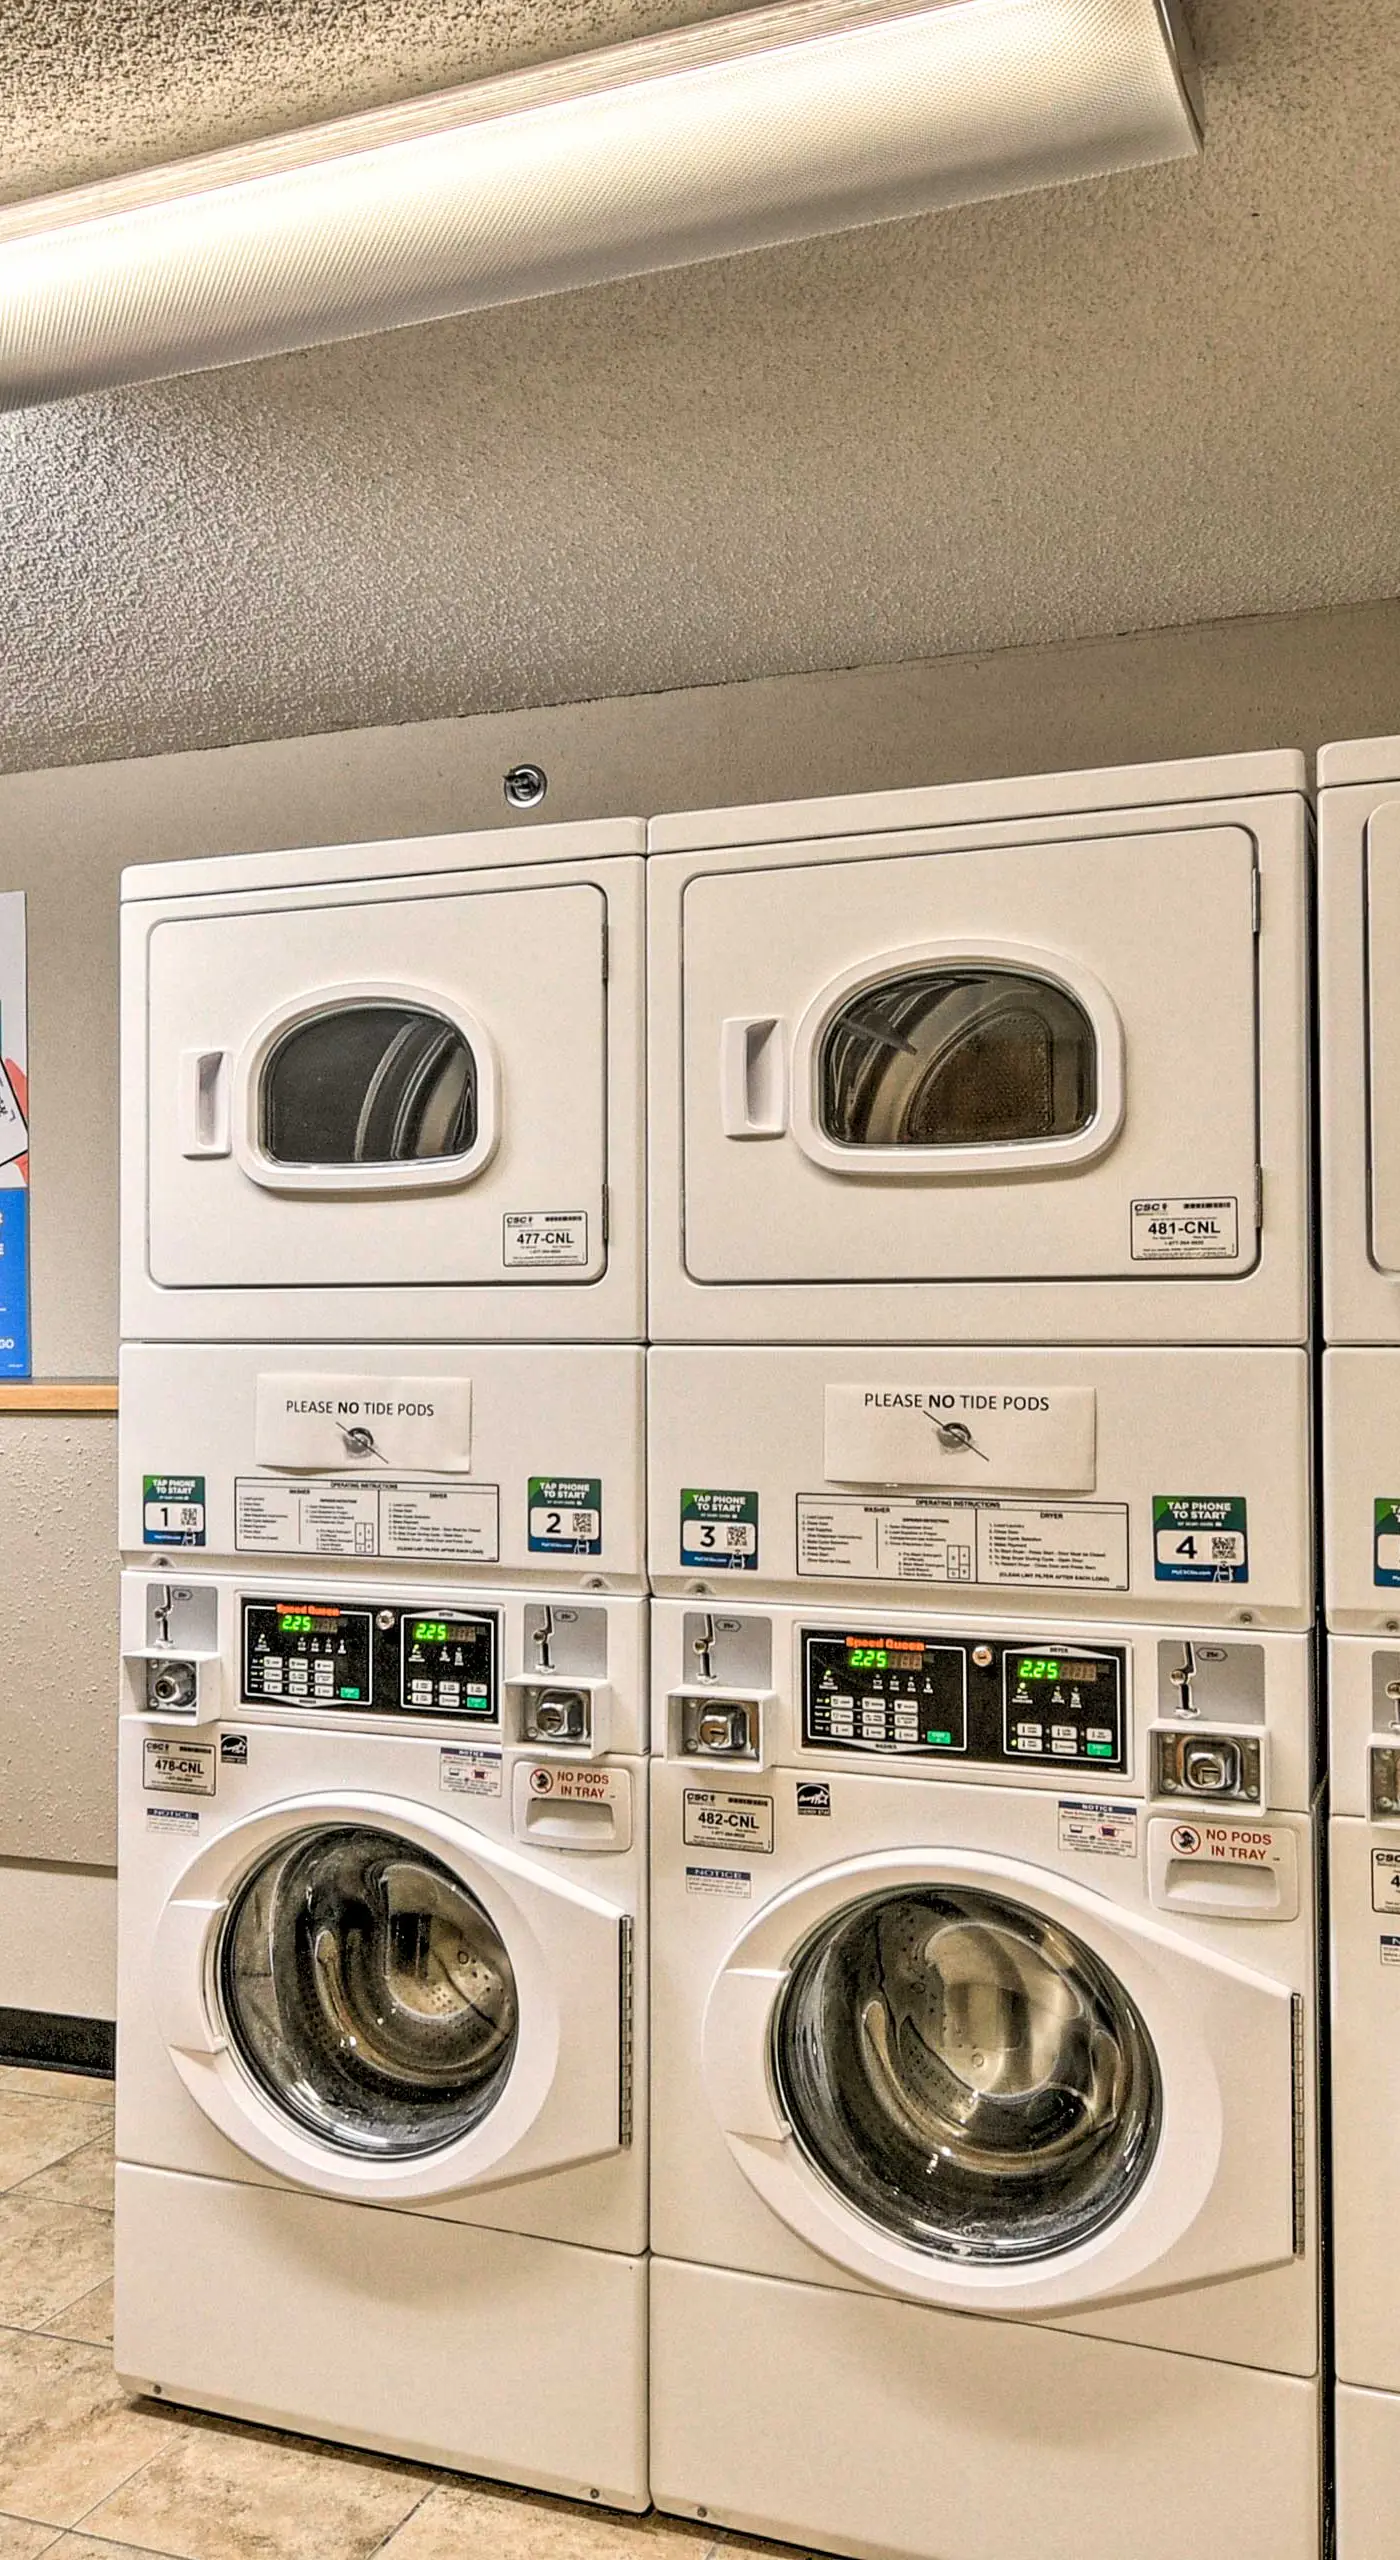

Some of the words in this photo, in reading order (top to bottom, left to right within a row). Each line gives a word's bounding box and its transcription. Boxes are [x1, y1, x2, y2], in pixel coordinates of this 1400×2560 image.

[1148, 1221, 1221, 1235] 481-CNL
[517, 1232, 574, 1244] 477-CNL
[286, 1400, 333, 1414] PLEASE
[338, 1402, 359, 1415] NO
[364, 1402, 393, 1416] TIDE
[397, 1403, 434, 1417] PODS
[863, 1392, 923, 1408] PLEASE
[928, 1394, 955, 1409] NO
[959, 1395, 997, 1410] TIDE
[1002, 1396, 1050, 1412] PODS
[168, 1480, 196, 1488] PHONE
[168, 1487, 192, 1495] START
[540, 1482, 557, 1490] TAP
[558, 1483, 590, 1492] PHONE
[543, 1490, 556, 1498] TO
[557, 1491, 586, 1499] START
[693, 1494, 711, 1503] TAP
[712, 1495, 746, 1505] PHONE
[697, 1503, 710, 1511] TO
[711, 1503, 742, 1513] START
[1167, 1502, 1190, 1510] TAP
[1191, 1502, 1231, 1511] PHONE
[160, 1507, 168, 1527] 1
[1172, 1511, 1189, 1519] TO
[1190, 1511, 1227, 1520] START
[546, 1512, 561, 1534] 2
[700, 1525, 716, 1548] 3
[1176, 1535, 1198, 1560] 4
[846, 1636, 884, 1648] Speed
[885, 1639, 925, 1651] Queen
[850, 1650, 888, 1668] 2.25
[1019, 1660, 1058, 1680] 2.25
[154, 1759, 205, 1774] 478-CNL
[557, 1771, 574, 1782] NO
[576, 1773, 610, 1785] PODS
[560, 1785, 572, 1796] IN
[575, 1786, 605, 1799] TRAY
[1082, 1804, 1113, 1812] NOTICE
[698, 1811, 760, 1829] 482-CNL
[1206, 1829, 1227, 1841] NO
[1231, 1831, 1272, 1846] PODS
[1211, 1845, 1225, 1856] IN
[1229, 1847, 1267, 1861] TRAY
[695, 1868, 742, 1879] NOTICE
